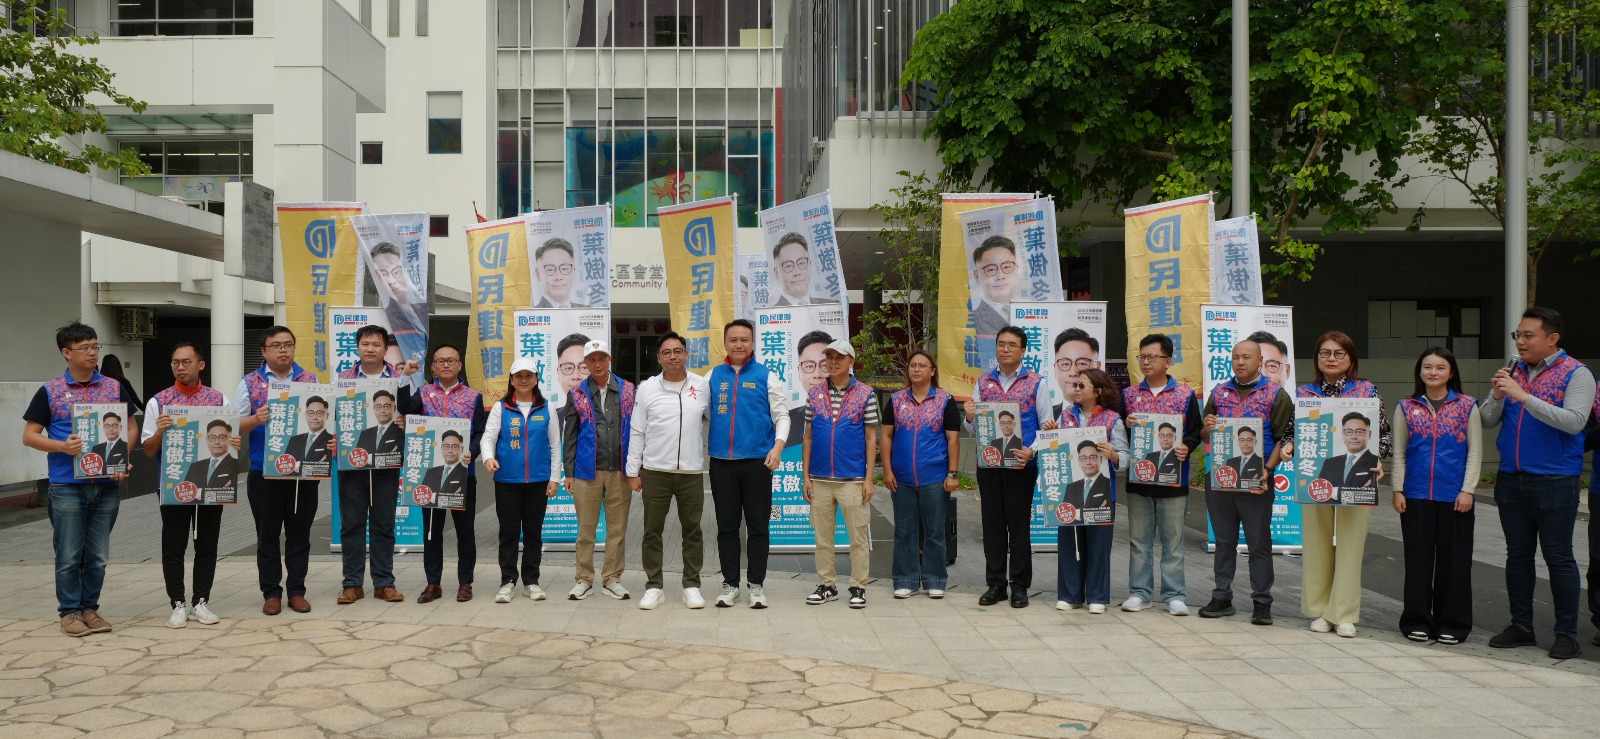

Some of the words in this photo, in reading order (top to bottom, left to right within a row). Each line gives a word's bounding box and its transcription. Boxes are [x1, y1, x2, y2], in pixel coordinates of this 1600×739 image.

[611, 280, 663, 289] Community
[528, 315, 551, 323] 民建聯
[769, 313, 791, 322] 民建聯
[1026, 308, 1048, 316] 民建聯
[1215, 311, 1237, 319] 民建聯
[717, 381, 730, 415] 李世榮
[268, 403, 286, 452] 葉傲冬
[287, 405, 295, 425] Chris
[338, 400, 355, 446] 葉傲冬
[77, 418, 90, 452] 葉傲冬
[186, 430, 195, 453] Chris
[977, 416, 988, 447] 葉傲冬
[1134, 428, 1145, 460] 葉傲冬
[1320, 423, 1328, 448] Chris
[166, 430, 184, 480] 葉傲冬
[406, 437, 424, 483] 葉傲冬
[1059, 452, 1068, 474] Chris
[1213, 431, 1224, 466] 葉傲冬
[1298, 422, 1318, 477] 葉傲冬
[1041, 452, 1062, 502] 葉傲冬
